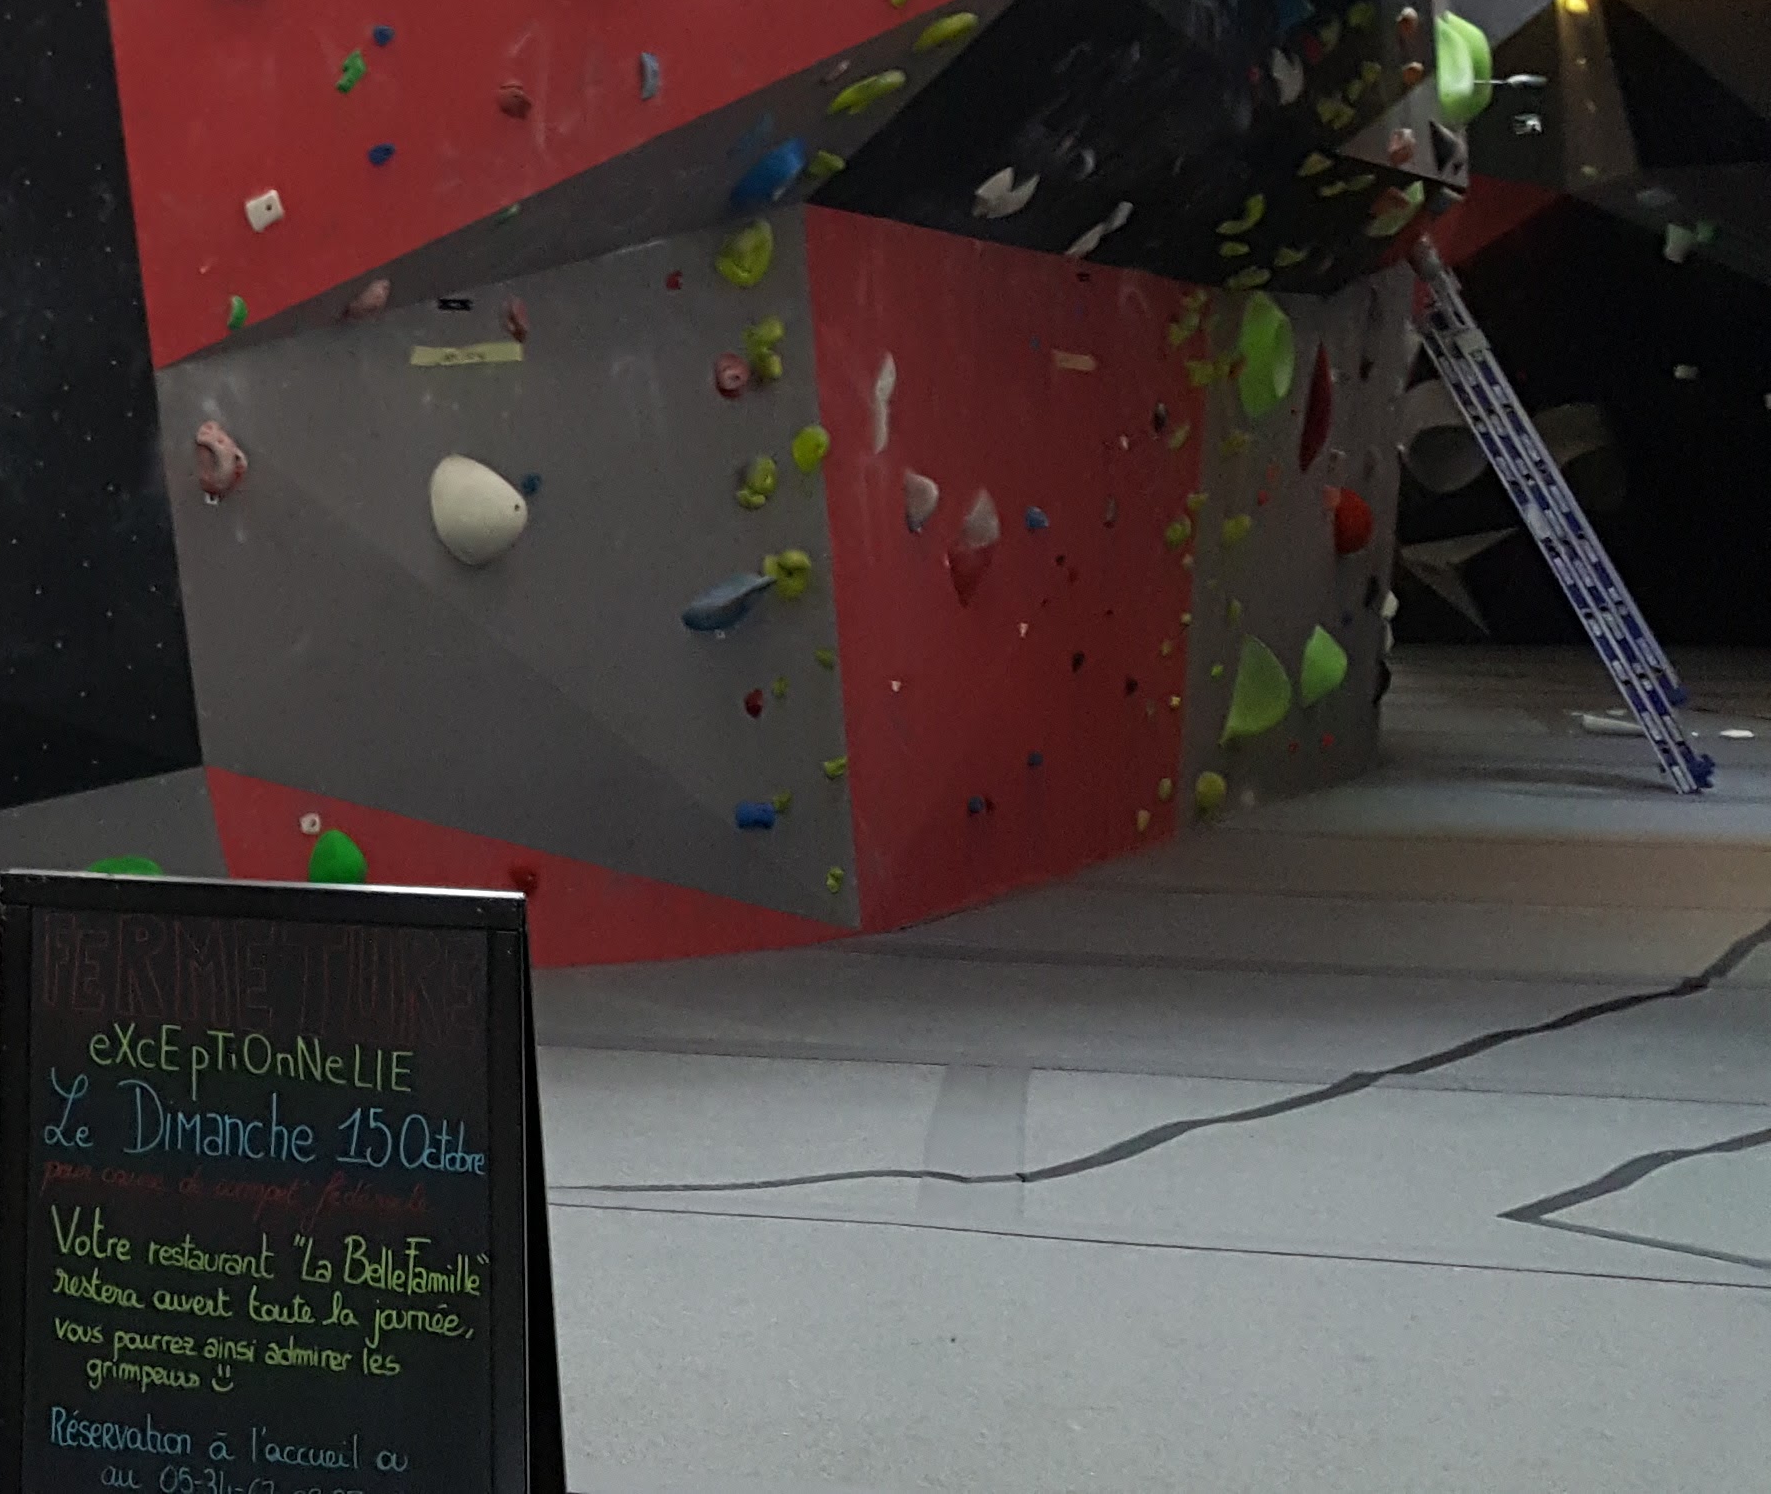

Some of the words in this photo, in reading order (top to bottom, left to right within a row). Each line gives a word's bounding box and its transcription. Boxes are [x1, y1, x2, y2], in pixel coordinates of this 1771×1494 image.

[43, 1066, 94, 1147] Le
[51, 1204, 132, 1261] Votre
[147, 1232, 275, 1278] restaurant
[52, 1267, 146, 1309] restera
[152, 1287, 233, 1317] ouvert
[248, 1284, 316, 1324] toute
[322, 1290, 359, 1326] la
[85, 1357, 202, 1394] grimpeurs
[112, 1330, 198, 1363] pourrez
[203, 1336, 258, 1363] ainsi
[264, 1335, 353, 1372] admirer
[362, 1347, 402, 1376] les
[251, 1425, 359, 1469] l'accueil
